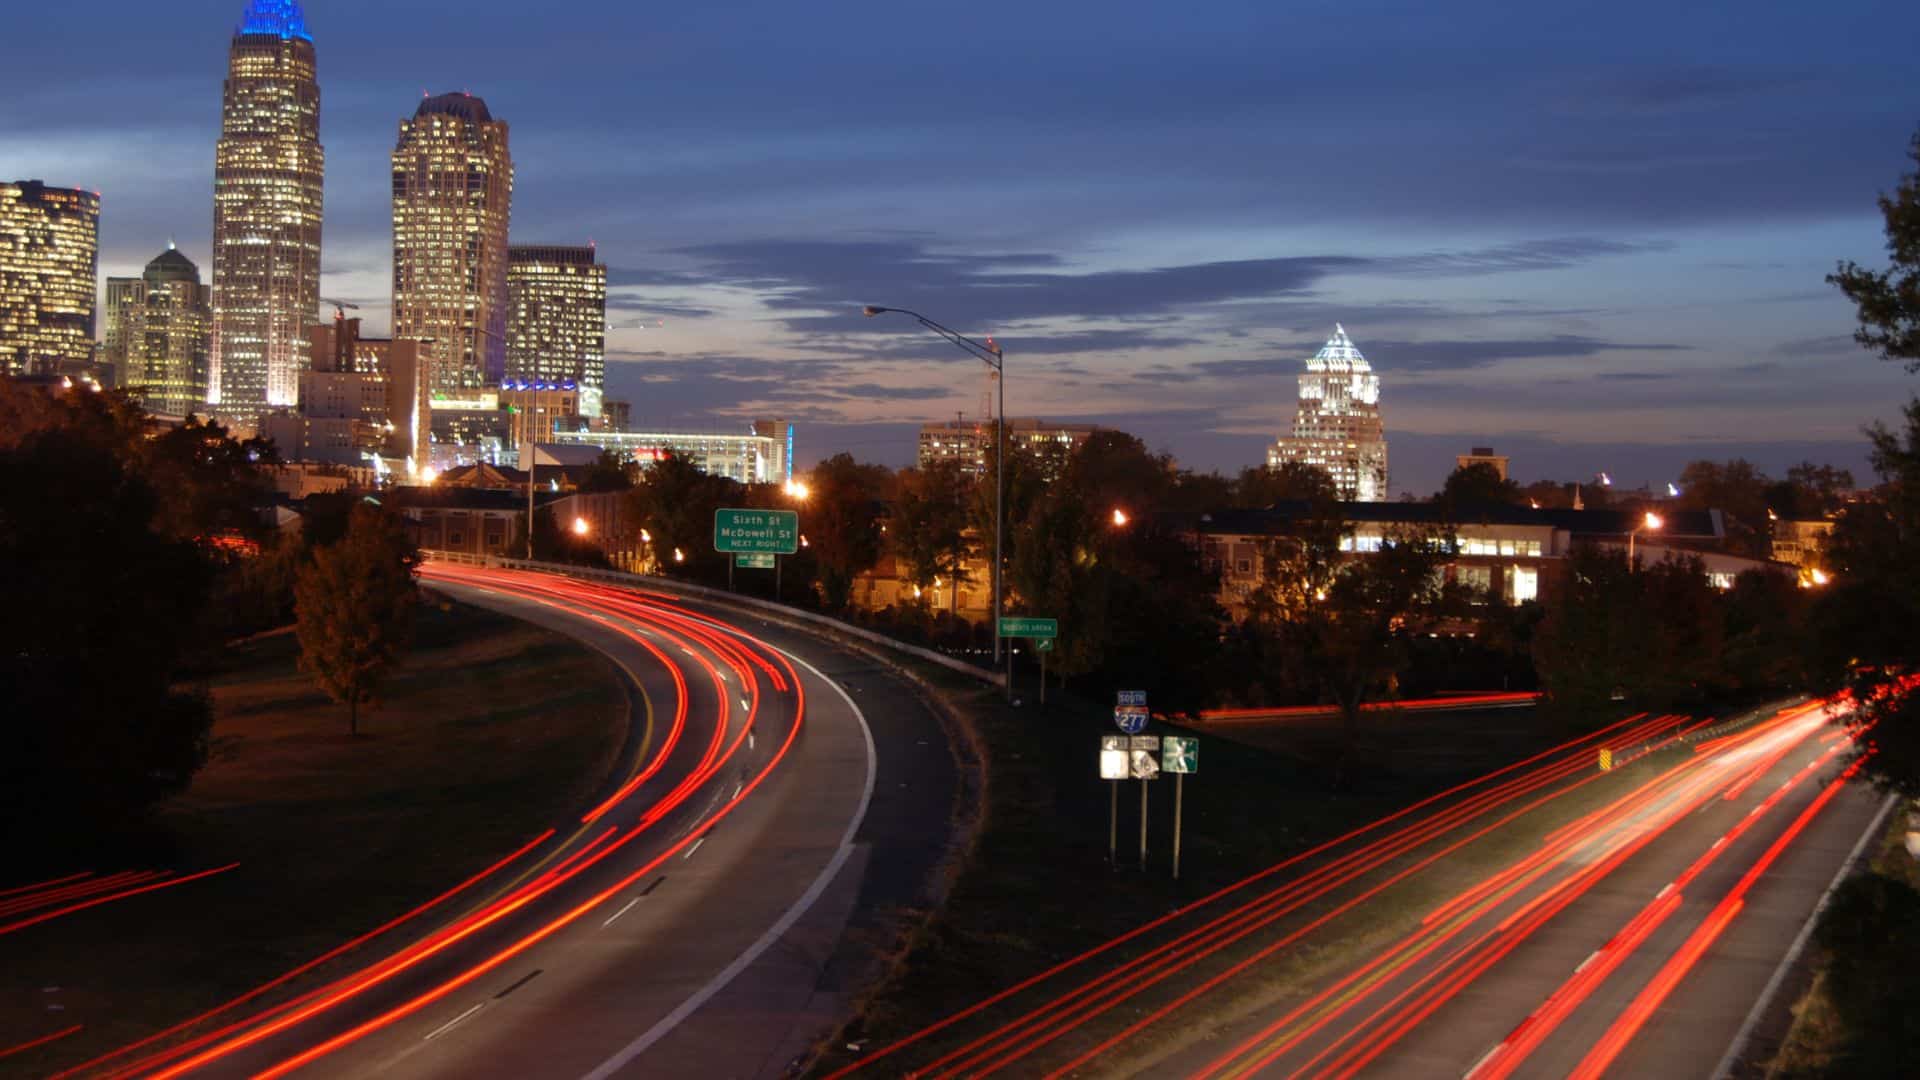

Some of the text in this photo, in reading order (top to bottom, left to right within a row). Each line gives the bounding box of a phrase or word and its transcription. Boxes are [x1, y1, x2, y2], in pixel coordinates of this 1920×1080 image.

[733, 515, 780, 526] Sixth St
[721, 527, 791, 539] McDowell St
[1120, 714, 1146, 727] 277
